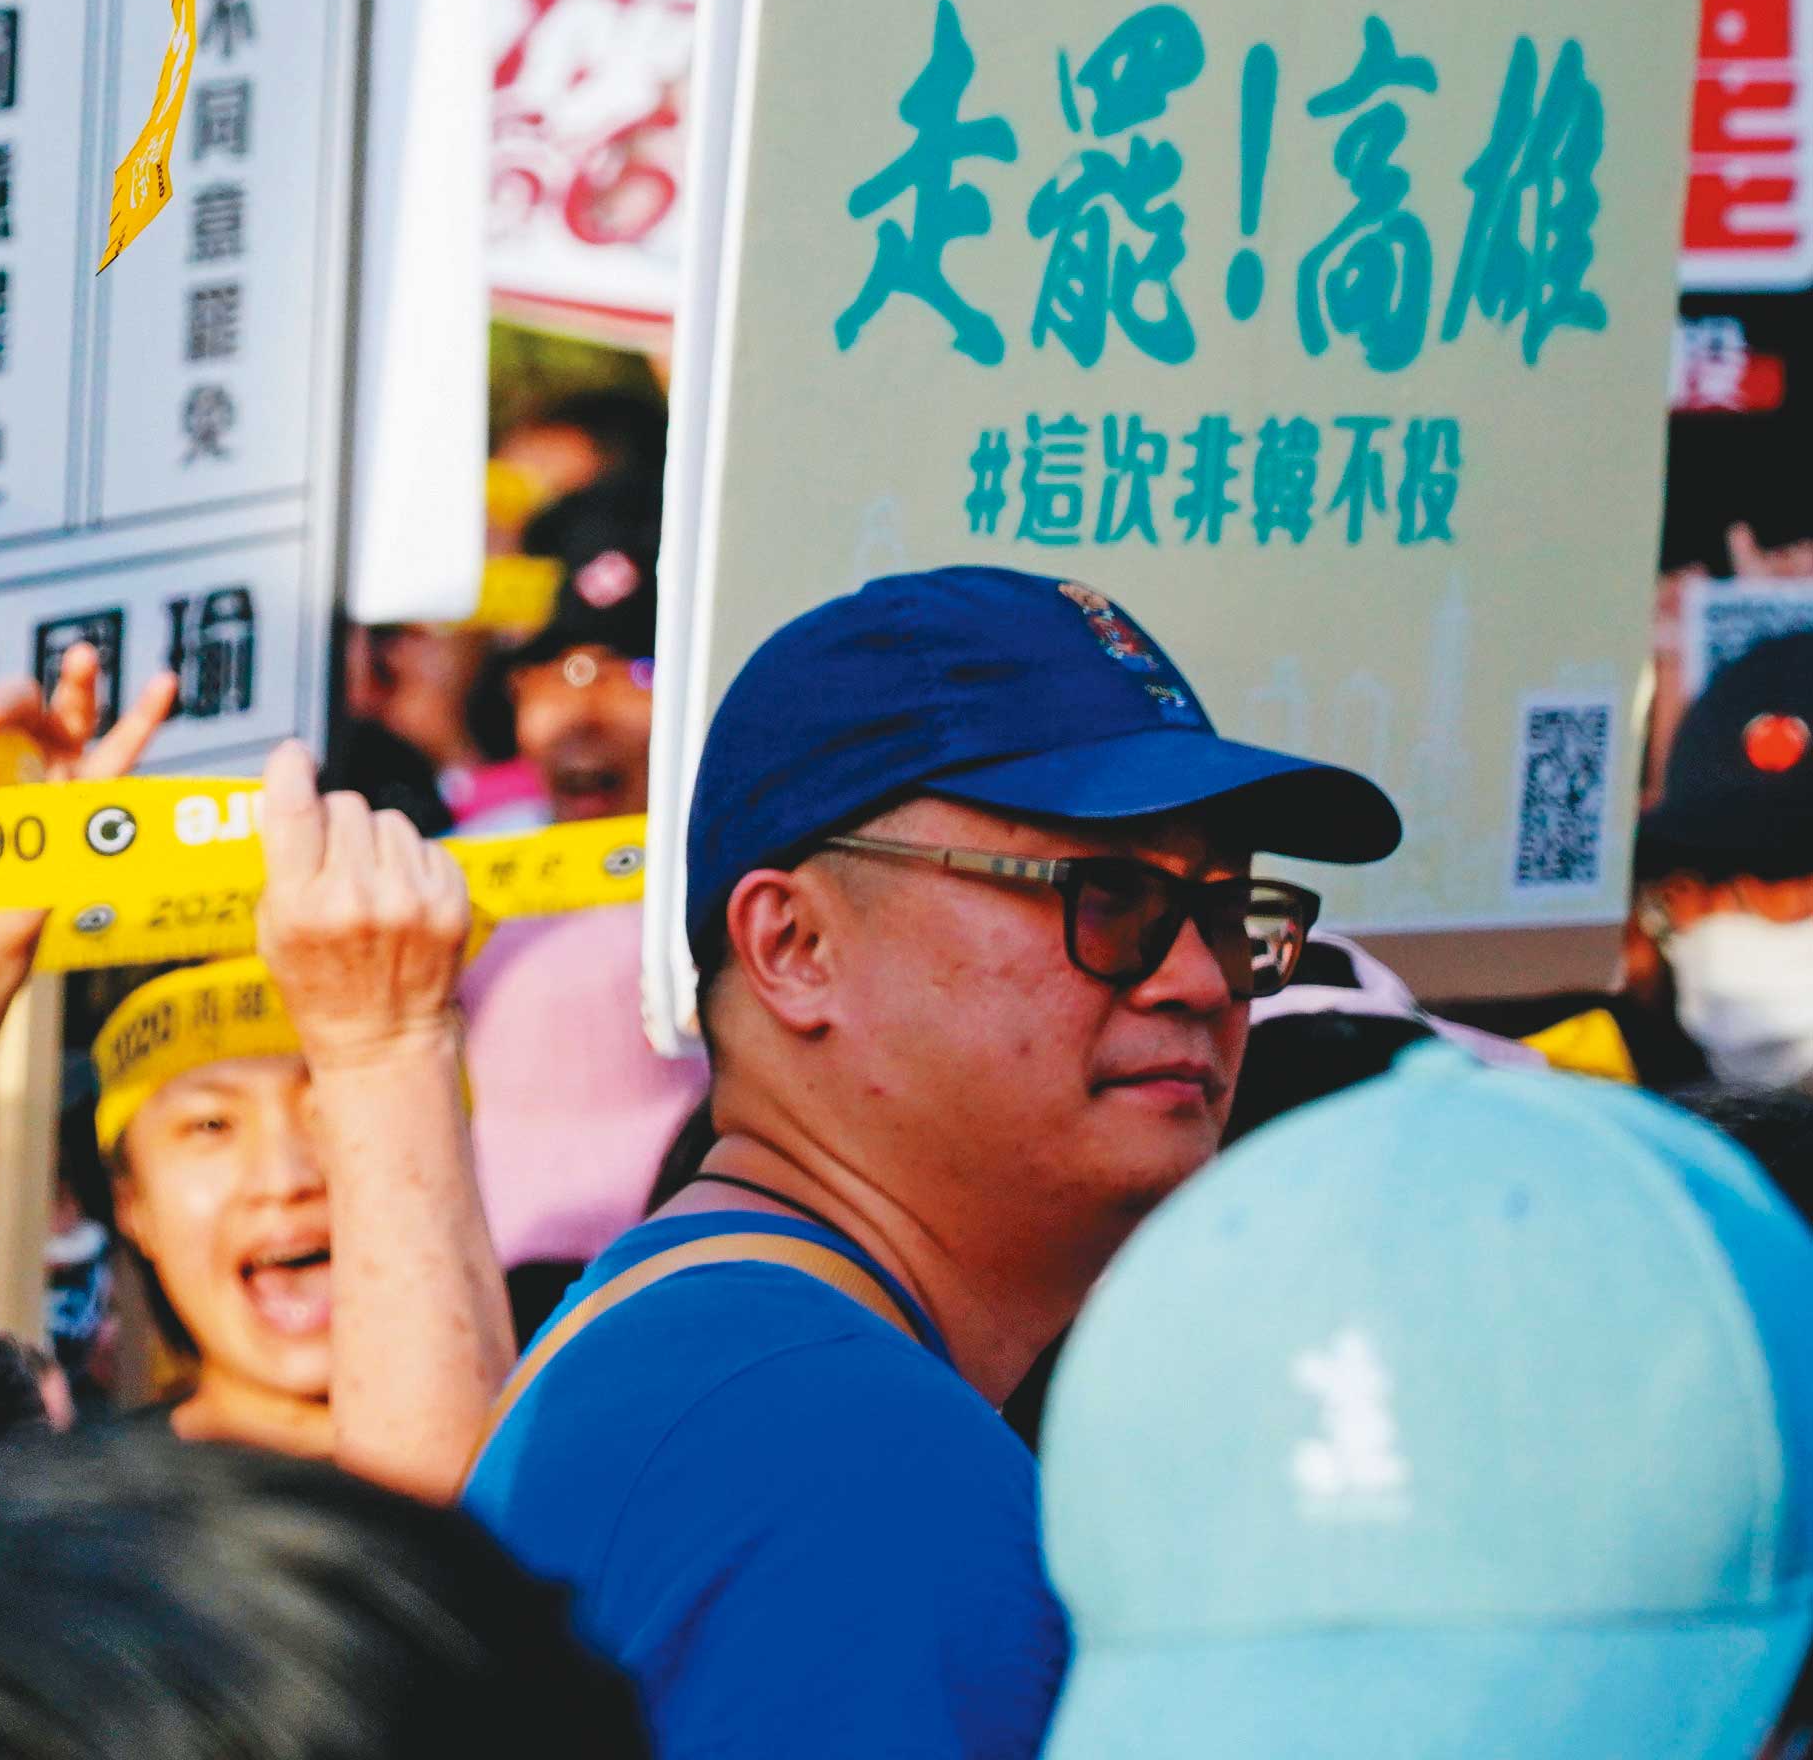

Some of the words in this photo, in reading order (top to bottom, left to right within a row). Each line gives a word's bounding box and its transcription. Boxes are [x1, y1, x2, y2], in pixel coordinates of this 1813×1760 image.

[966, 412, 1465, 549] #這次非韓不投
